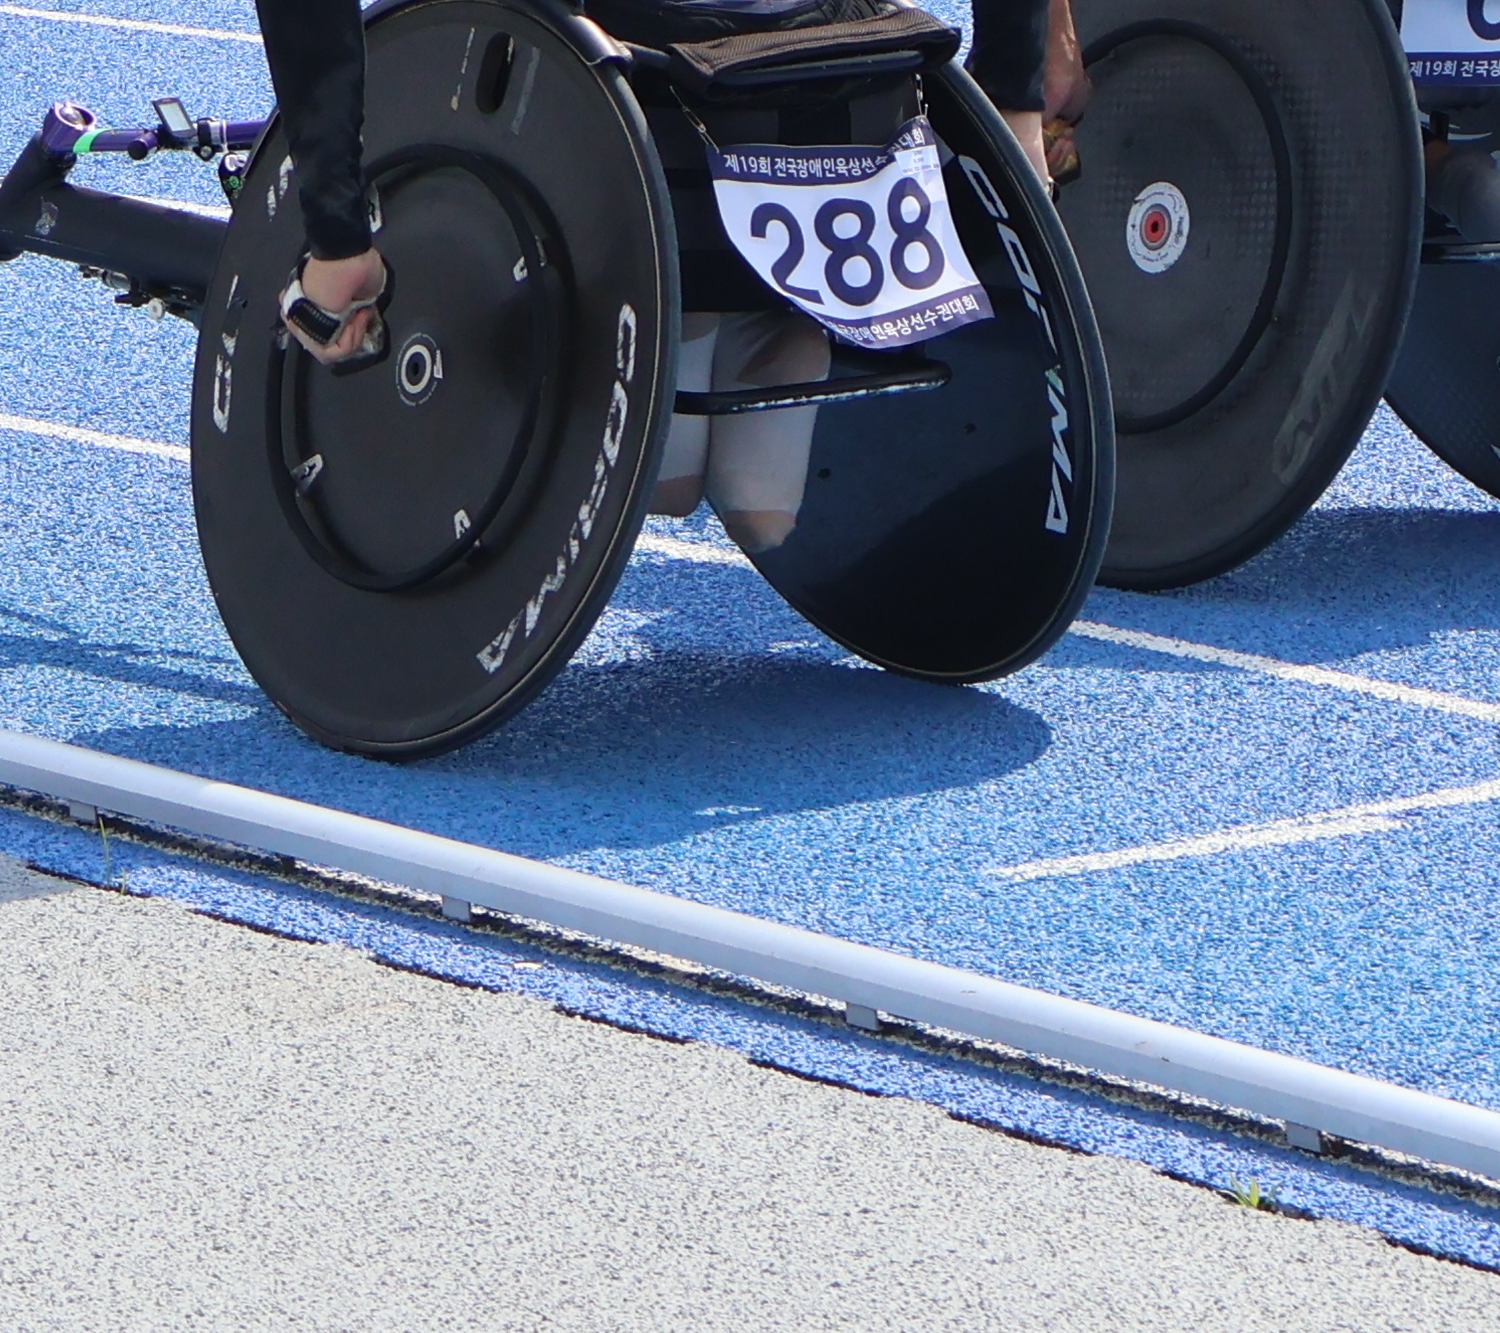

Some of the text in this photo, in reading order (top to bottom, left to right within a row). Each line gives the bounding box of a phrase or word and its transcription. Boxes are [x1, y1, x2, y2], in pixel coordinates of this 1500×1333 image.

[1409, 59, 1458, 78] 제19회
[723, 153, 771, 177] 제19회
[750, 176, 945, 308] 288
